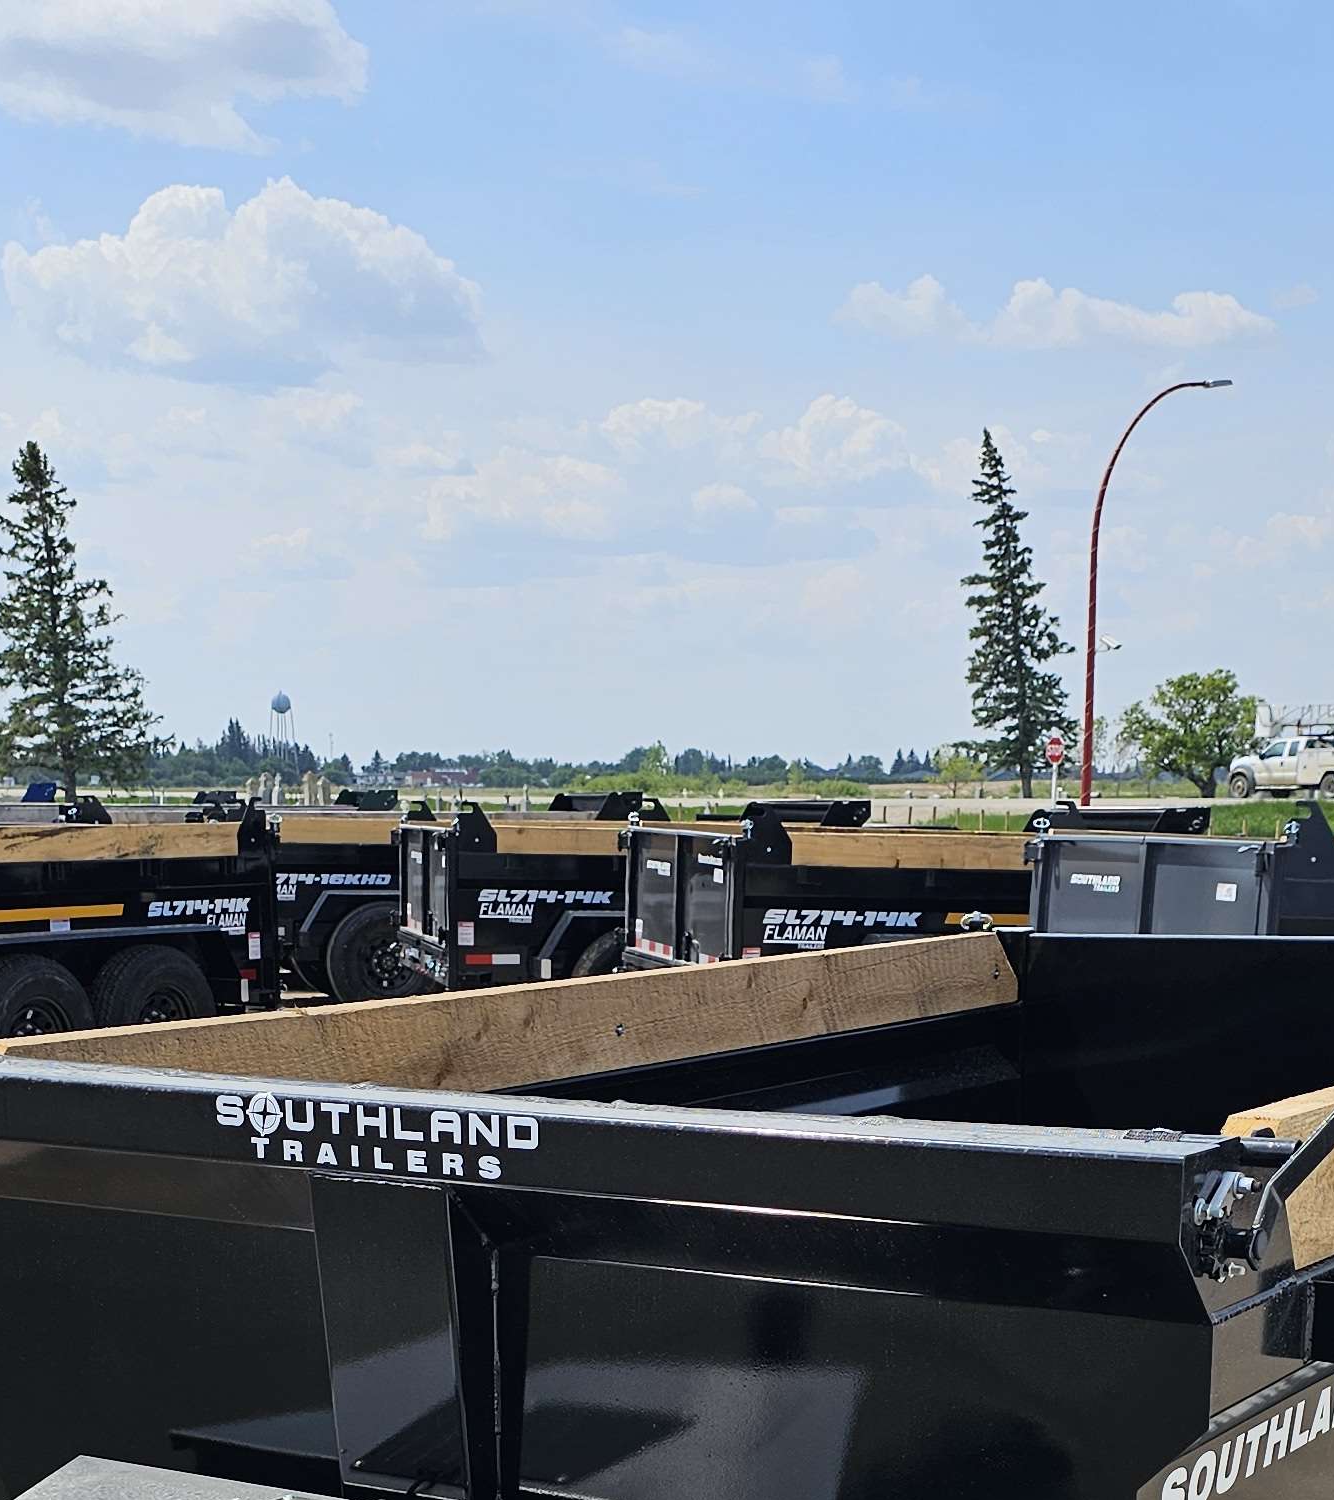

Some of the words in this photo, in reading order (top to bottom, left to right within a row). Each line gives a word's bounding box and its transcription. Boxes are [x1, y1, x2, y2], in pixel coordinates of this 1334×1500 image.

[276, 873, 391, 885] 714-16KHD
[478, 889, 615, 904] SL714-14K
[148, 898, 251, 918] SL714-14K
[480, 903, 534, 916] FLAMAN
[763, 909, 923, 928] SL714-14K
[764, 925, 827, 940] FLAMAN
[215, 1092, 539, 1150] SOUTHLAND
[251, 1136, 502, 1180] TRAILERS
